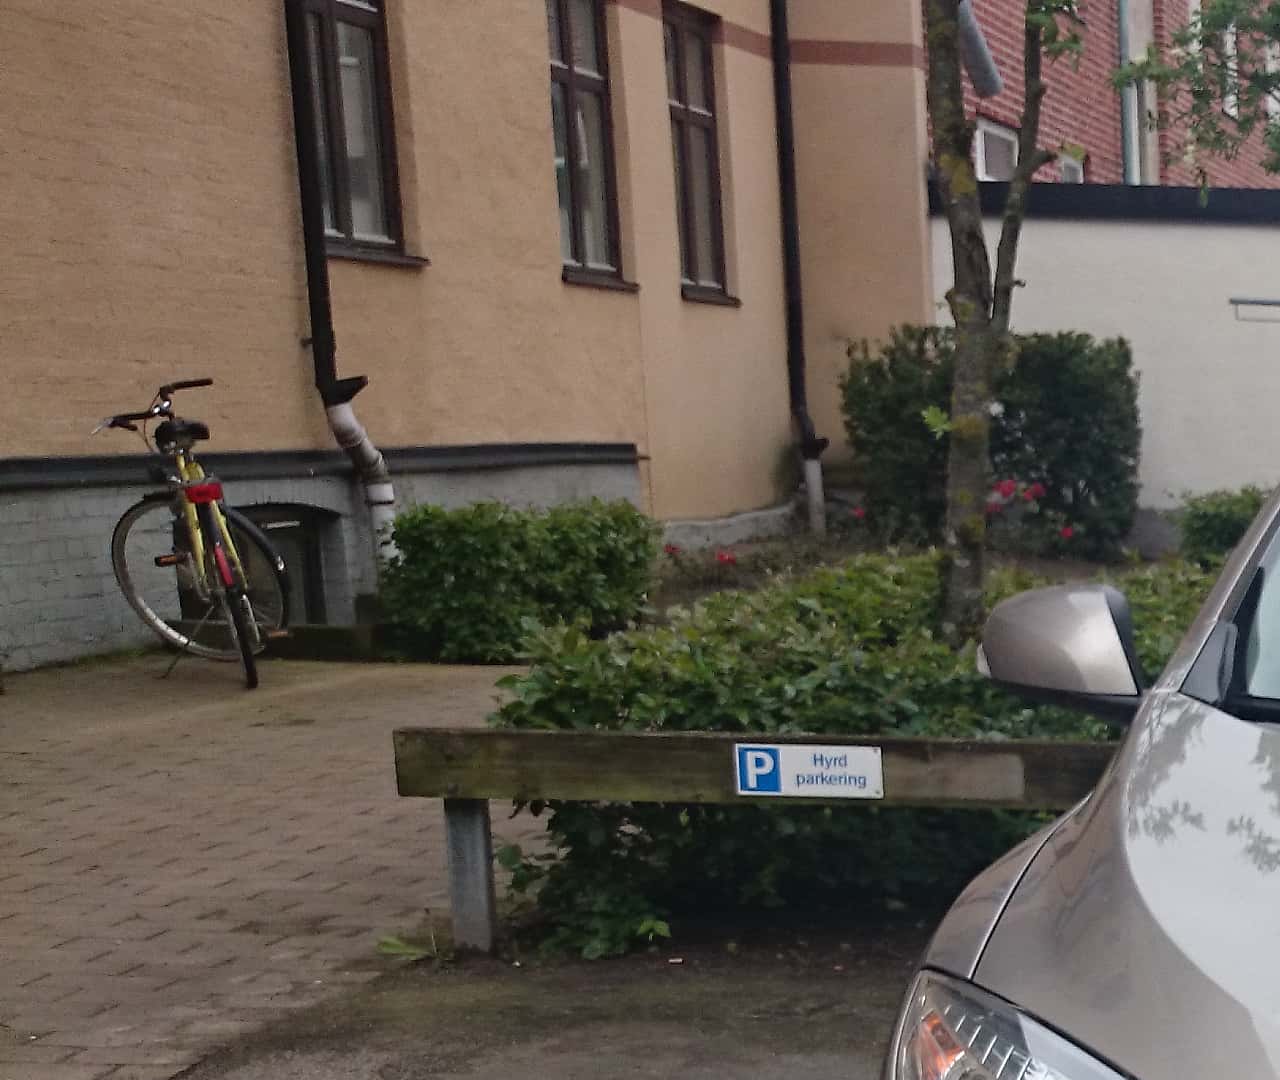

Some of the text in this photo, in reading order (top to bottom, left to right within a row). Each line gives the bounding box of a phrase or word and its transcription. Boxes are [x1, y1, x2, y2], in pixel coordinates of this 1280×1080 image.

[812, 753, 848, 769] Hyrd
[746, 750, 775, 789] P
[796, 772, 867, 788] parkering
